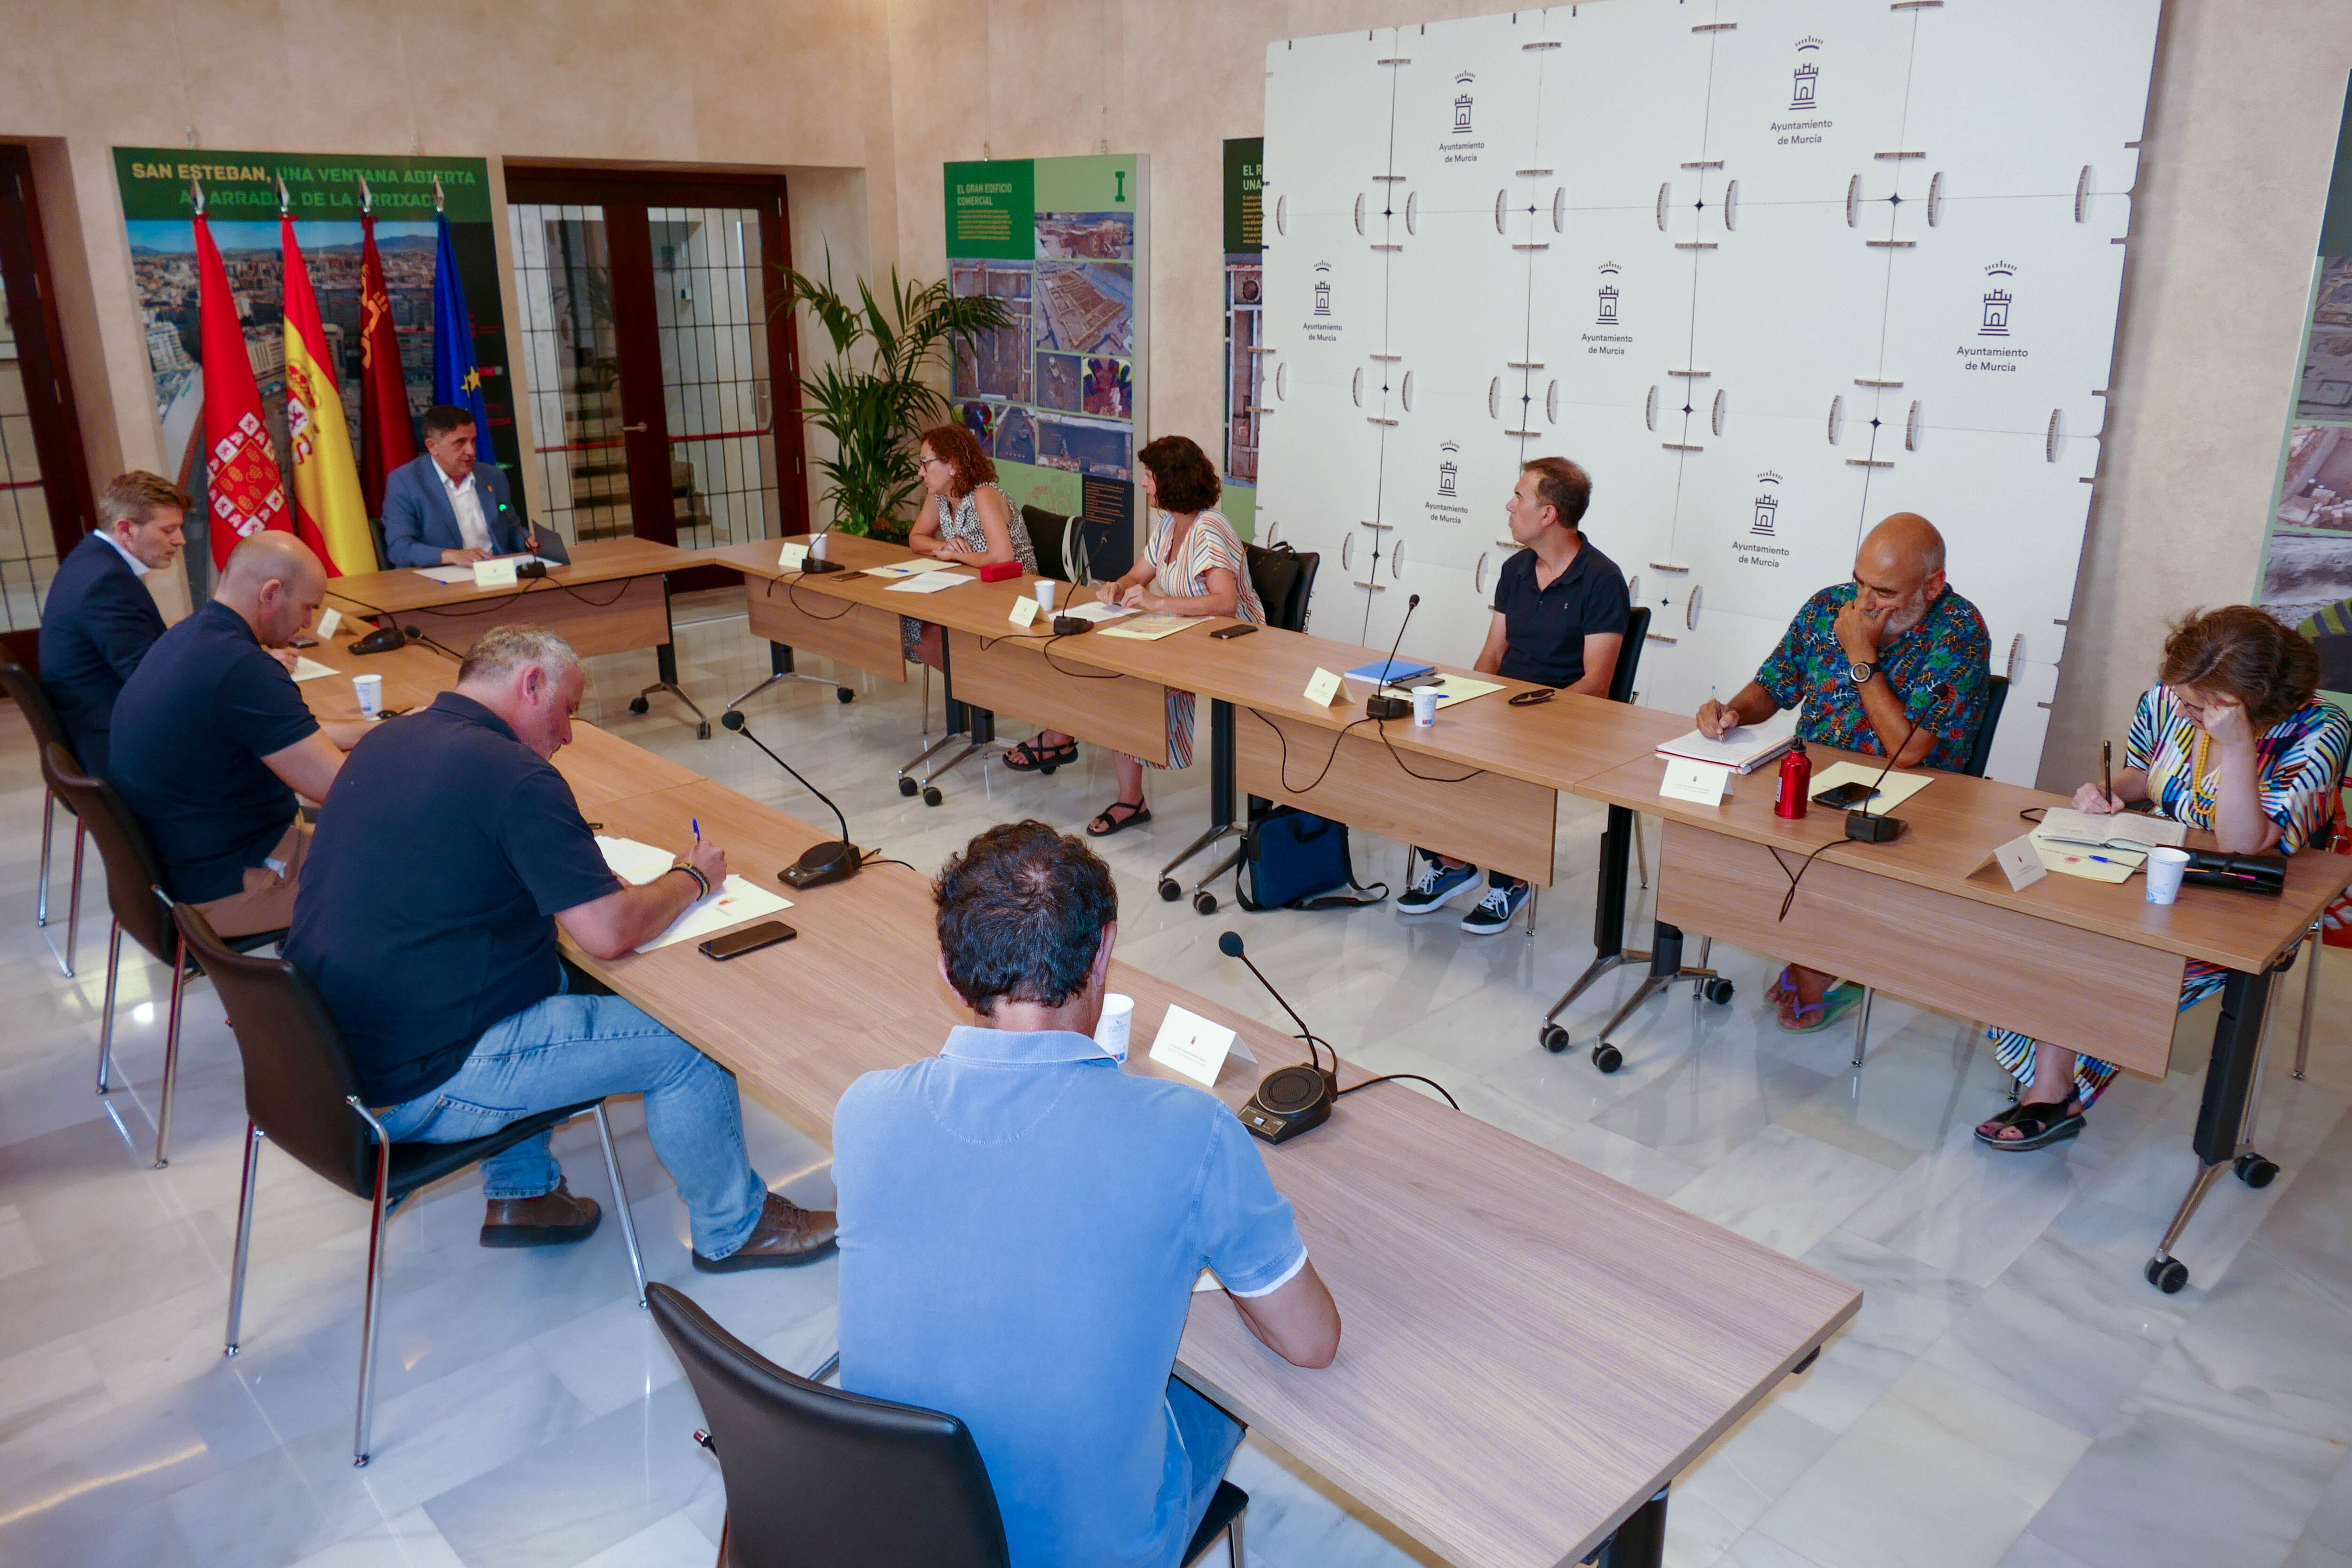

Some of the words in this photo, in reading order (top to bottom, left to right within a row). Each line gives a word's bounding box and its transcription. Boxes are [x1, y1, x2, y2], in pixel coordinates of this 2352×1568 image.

[1771, 119, 1833, 132] Ayuntamiento
[1791, 135, 1821, 144] Murcia
[1439, 142, 1485, 152] Ayuntamiento
[132, 163, 173, 179] SAN
[178, 164, 272, 183] ESTEBAN,
[276, 167, 313, 182] UNA
[317, 167, 398, 183] VENTANA
[403, 169, 476, 184] ABIERTA
[1243, 165, 1254, 176] EL
[1243, 179, 1262, 191] UNA
[301, 191, 325, 206] DE
[330, 192, 352, 207] LA
[1582, 334, 1632, 342] Ayuntamiento
[1957, 346, 2028, 357] Ayuntamiento
[1965, 361, 1977, 370] de
[1980, 362, 2016, 371] Murcia
[1425, 501, 1468, 513] Ayuntamiento
[1440, 515, 1461, 524] Murcia
[1732, 541, 1789, 556] Ayuntamiento
[1751, 557, 1779, 567] Murcia
